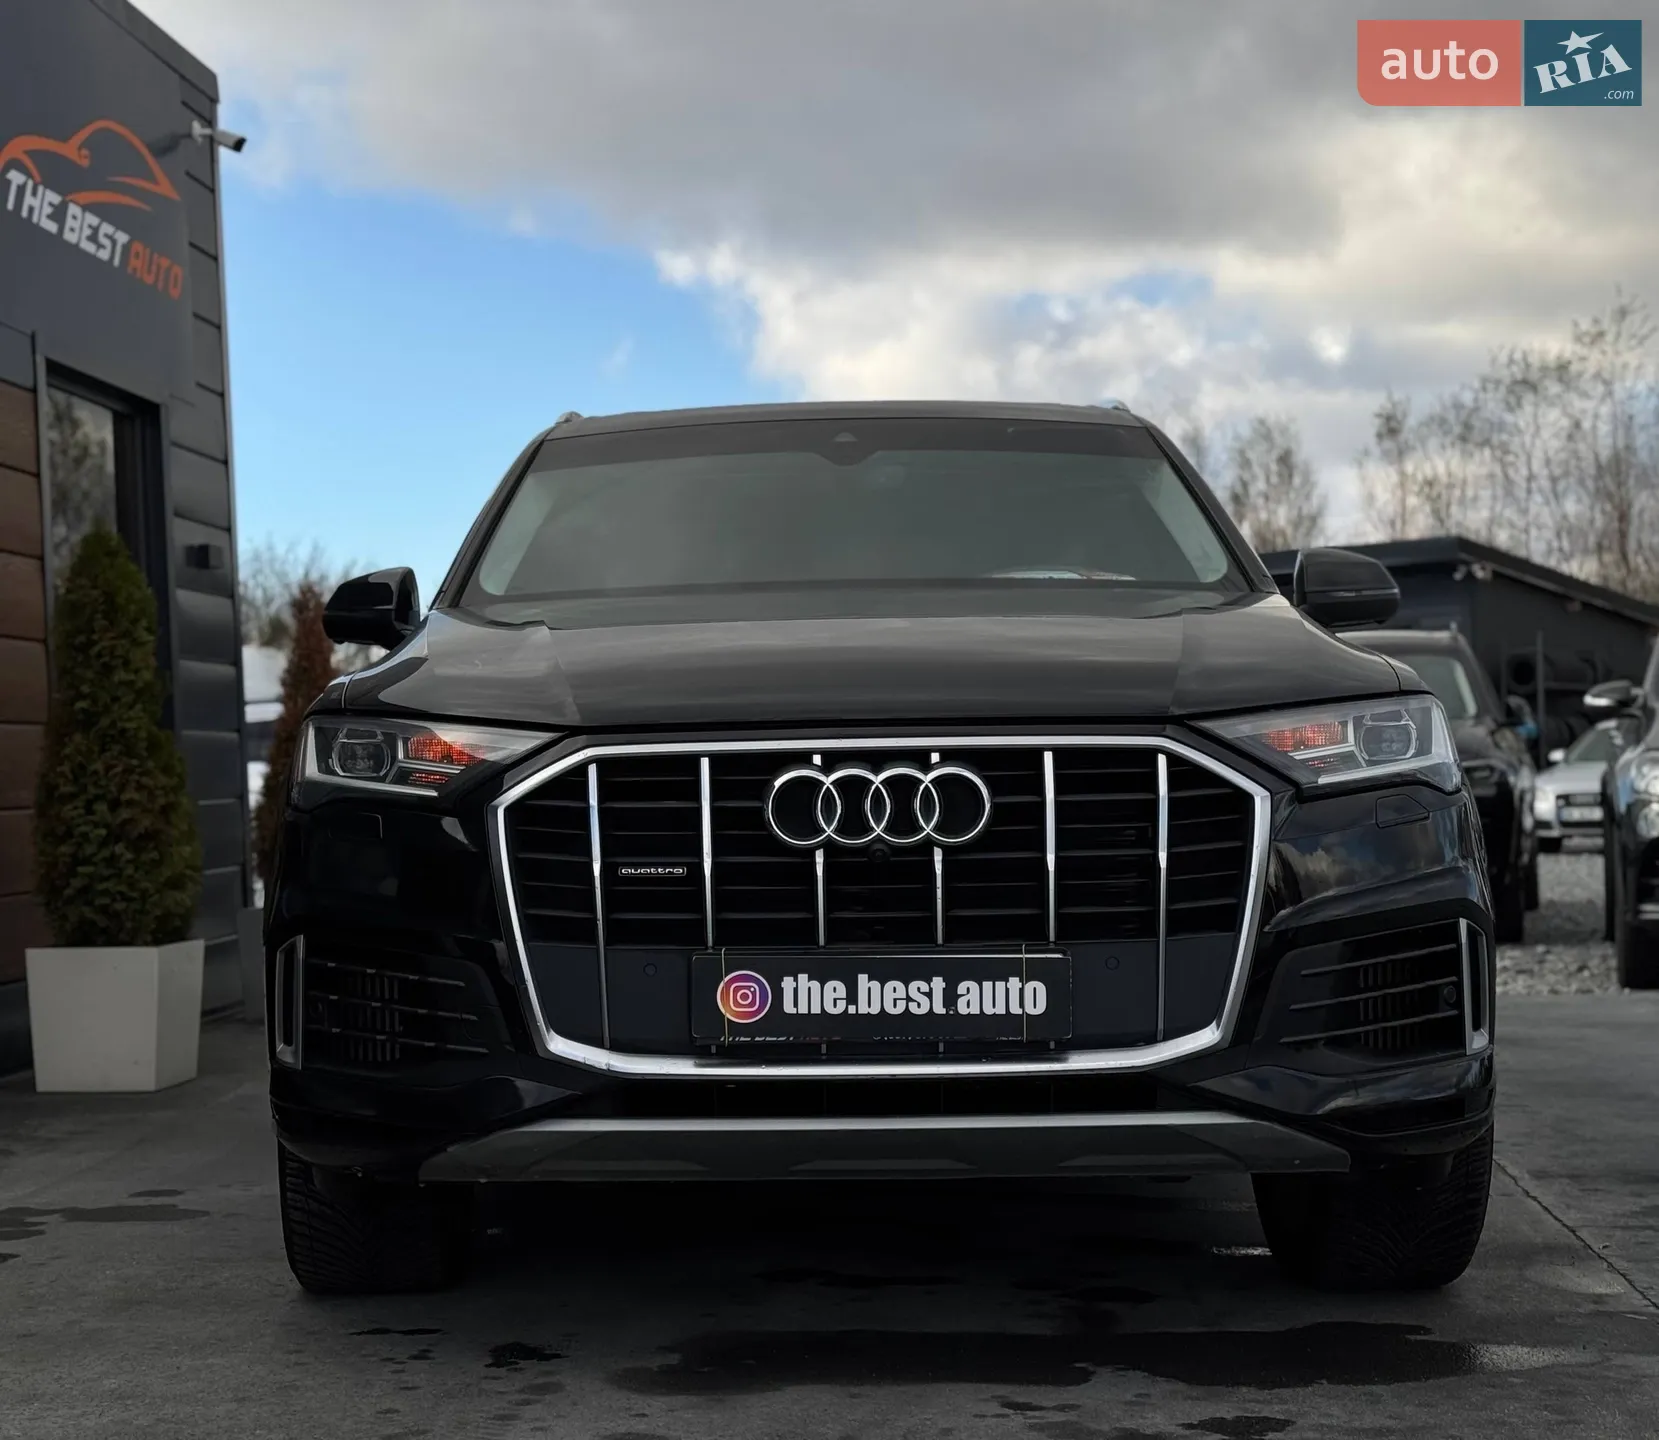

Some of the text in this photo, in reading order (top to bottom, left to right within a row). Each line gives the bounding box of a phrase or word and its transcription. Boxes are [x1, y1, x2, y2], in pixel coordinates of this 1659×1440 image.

[5, 168, 184, 300] THE BEST AUTO
[621, 867, 684, 876] quattro
